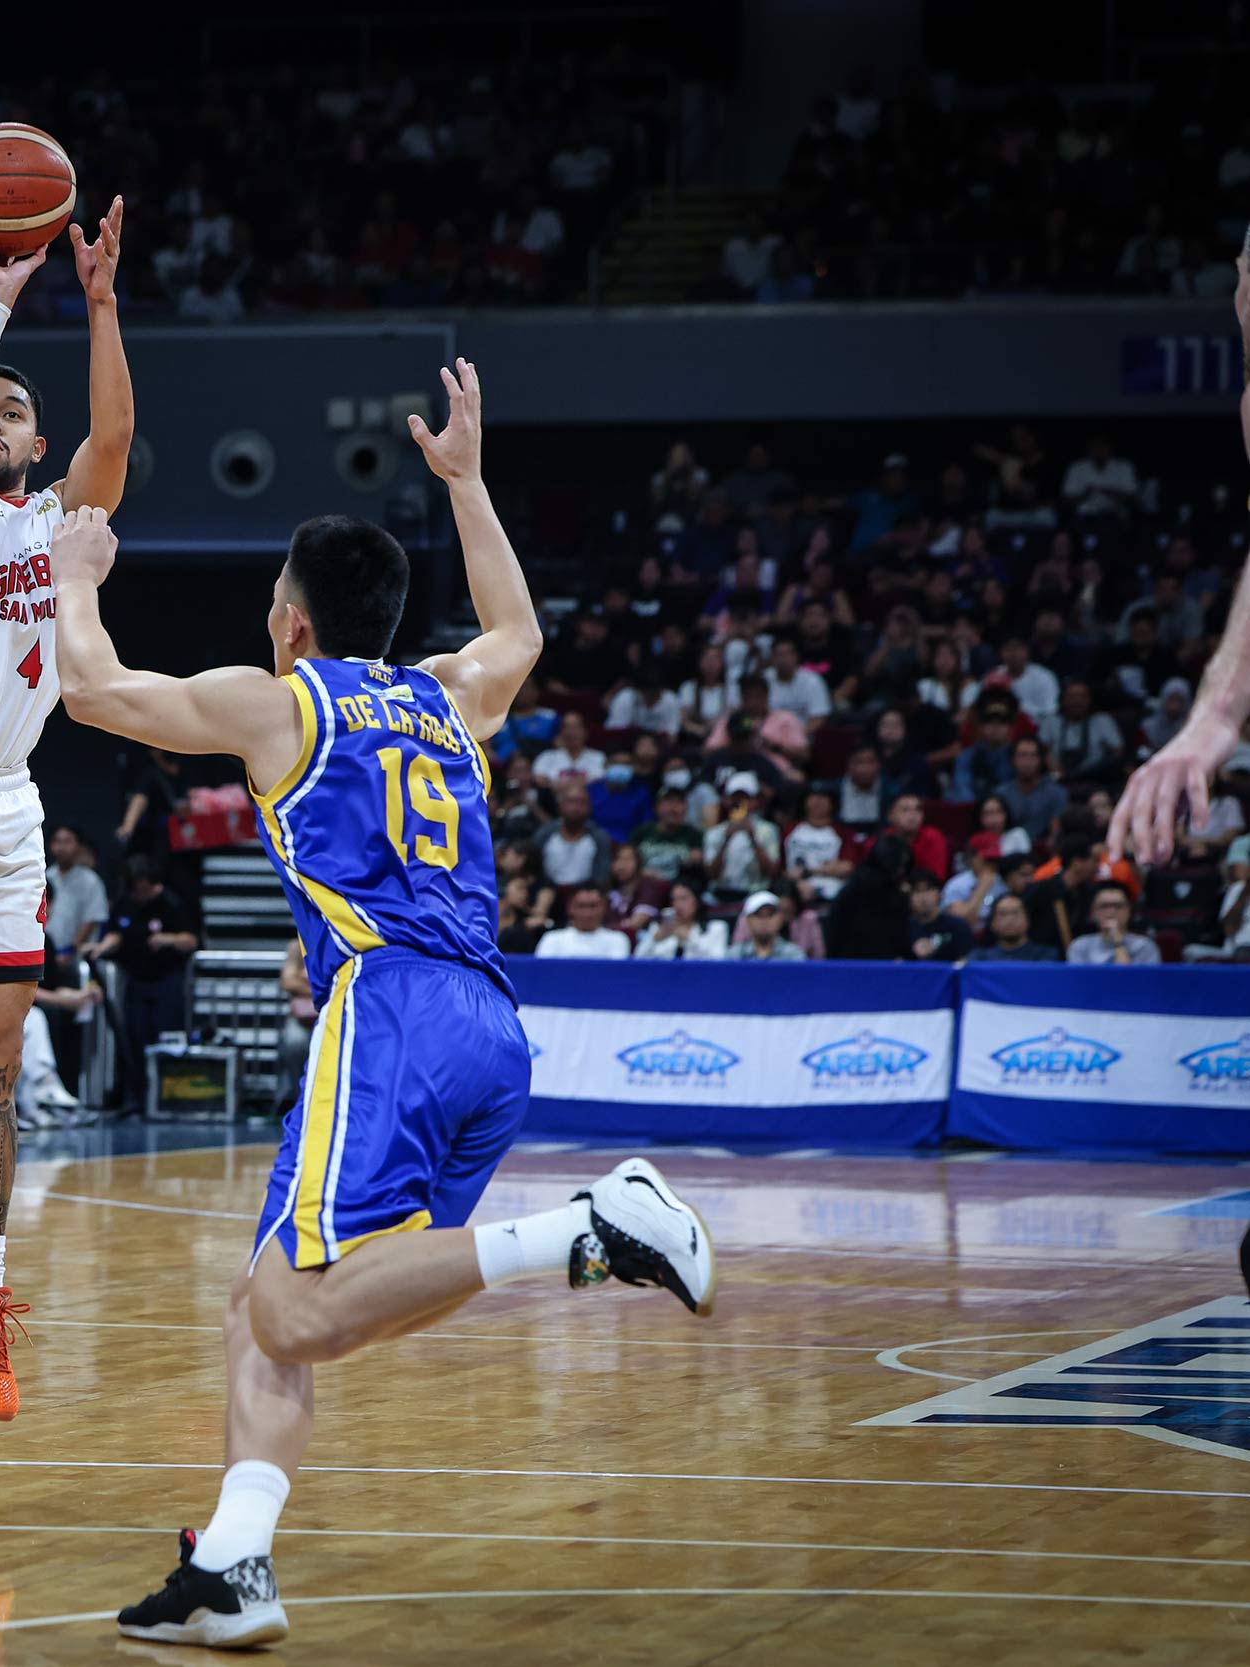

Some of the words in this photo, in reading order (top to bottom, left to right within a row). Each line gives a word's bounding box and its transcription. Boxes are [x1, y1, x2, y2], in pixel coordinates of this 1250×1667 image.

[17, 639, 42, 688] 4
[335, 694, 382, 733] DE
[378, 697, 415, 736] LA
[376, 747, 460, 872] 19
[629, 1052, 726, 1075] ARENA
[814, 1052, 915, 1075] ARENA
[1003, 1050, 1106, 1073] ARENA
